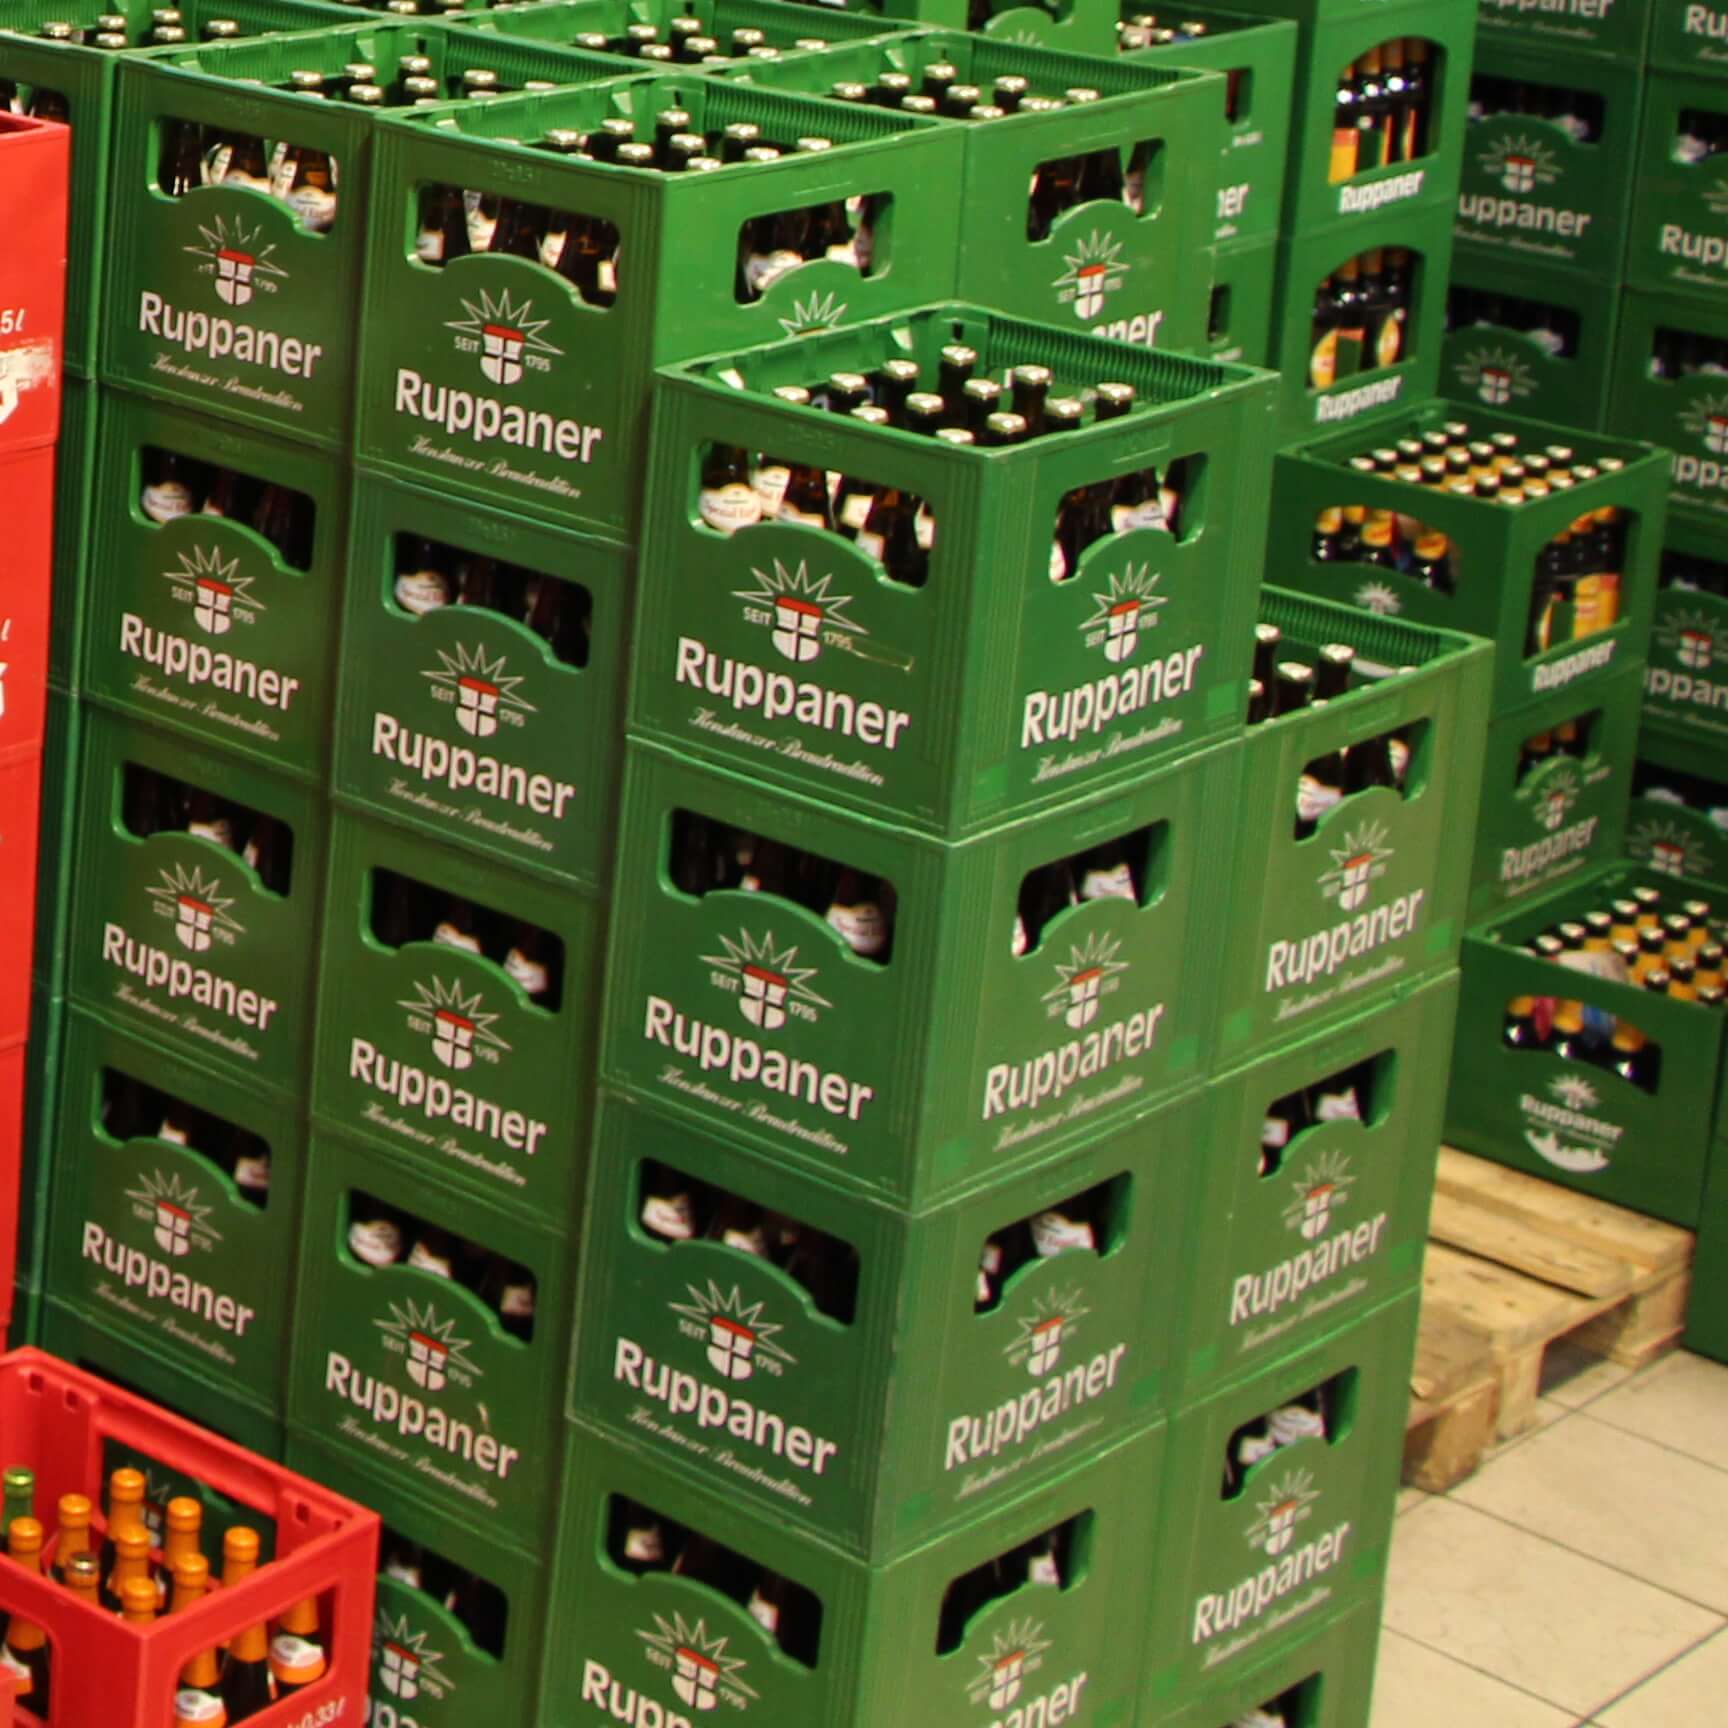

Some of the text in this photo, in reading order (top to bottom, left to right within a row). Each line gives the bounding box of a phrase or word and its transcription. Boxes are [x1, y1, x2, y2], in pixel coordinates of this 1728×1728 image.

[1339, 170, 1424, 215] Ruppaner
[139, 291, 323, 379] Ruppaner
[453, 334, 480, 353] SEIT
[395, 368, 602, 463] Ruppaner
[1315, 374, 1402, 423] Ruppaner
[171, 586, 193, 603] SEIT
[742, 605, 854, 652] SEIT 1795
[120, 613, 298, 711] Ruppaner
[429, 685, 455, 702] SEIT
[675, 635, 910, 751] Ruppaner
[1021, 643, 1203, 750] Ruppaner
[1532, 639, 1616, 693] Ruppaner
[372, 712, 574, 820] Ruppaner
[103, 922, 277, 1031] Ruppaner
[710, 971, 739, 994] SEIT
[1264, 887, 1424, 994] Ruppaner
[406, 1014, 432, 1034] SEIT
[643, 994, 873, 1122] Ruppaner
[982, 1003, 1165, 1122] Ruppaner
[349, 1037, 547, 1155] Ruppaner
[81, 1221, 254, 1337] Ruppaner
[1229, 1214, 1385, 1326] Ruppaner
[678, 1319, 706, 1342] SEIT
[325, 1351, 518, 1479] Ruppaner
[613, 1336, 836, 1475] Ruppaner
[944, 1342, 1127, 1472] Ruppaner
[1192, 1521, 1349, 1645] Ruppaner
